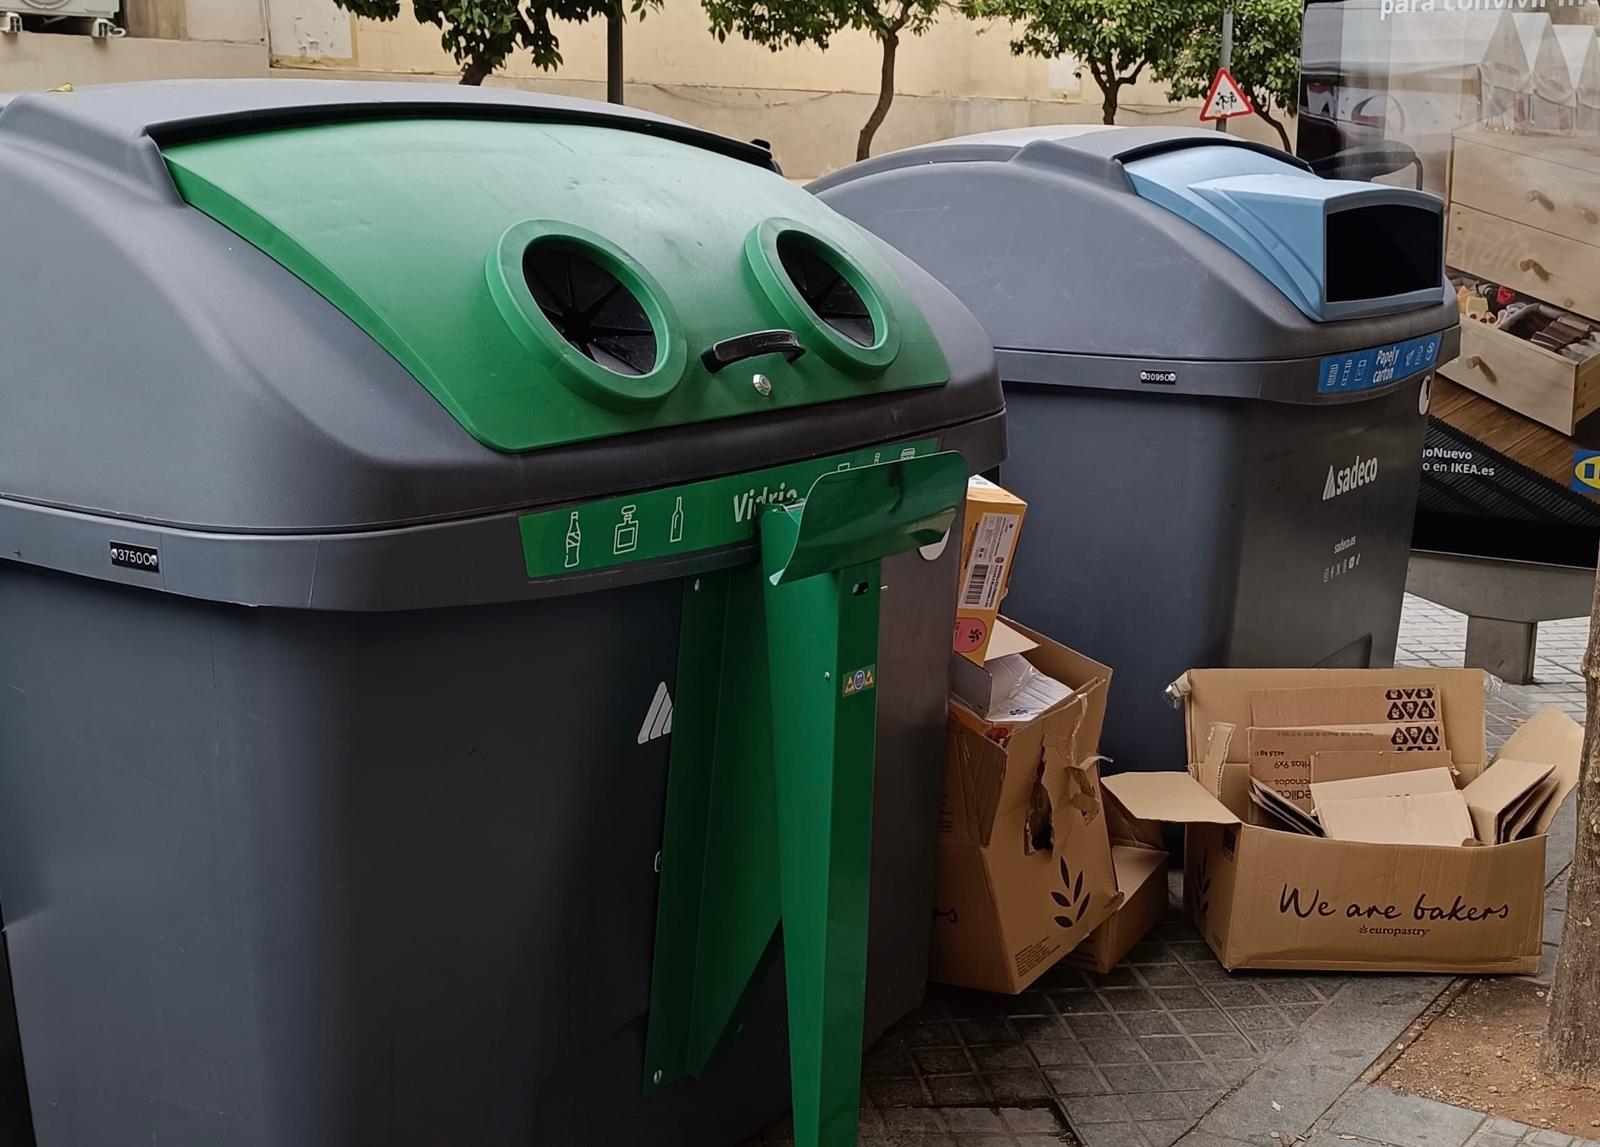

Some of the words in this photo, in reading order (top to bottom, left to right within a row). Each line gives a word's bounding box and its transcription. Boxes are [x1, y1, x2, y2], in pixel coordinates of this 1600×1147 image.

[1380, 0, 1434, 20] para
[1433, 463, 1448, 472] en
[1450, 462, 1495, 476] IKEA.es
[1274, 761, 1289, 769] 9x9
[1279, 883, 1336, 918] We
[1346, 902, 1402, 920] are
[1413, 893, 1508, 921] bakers
